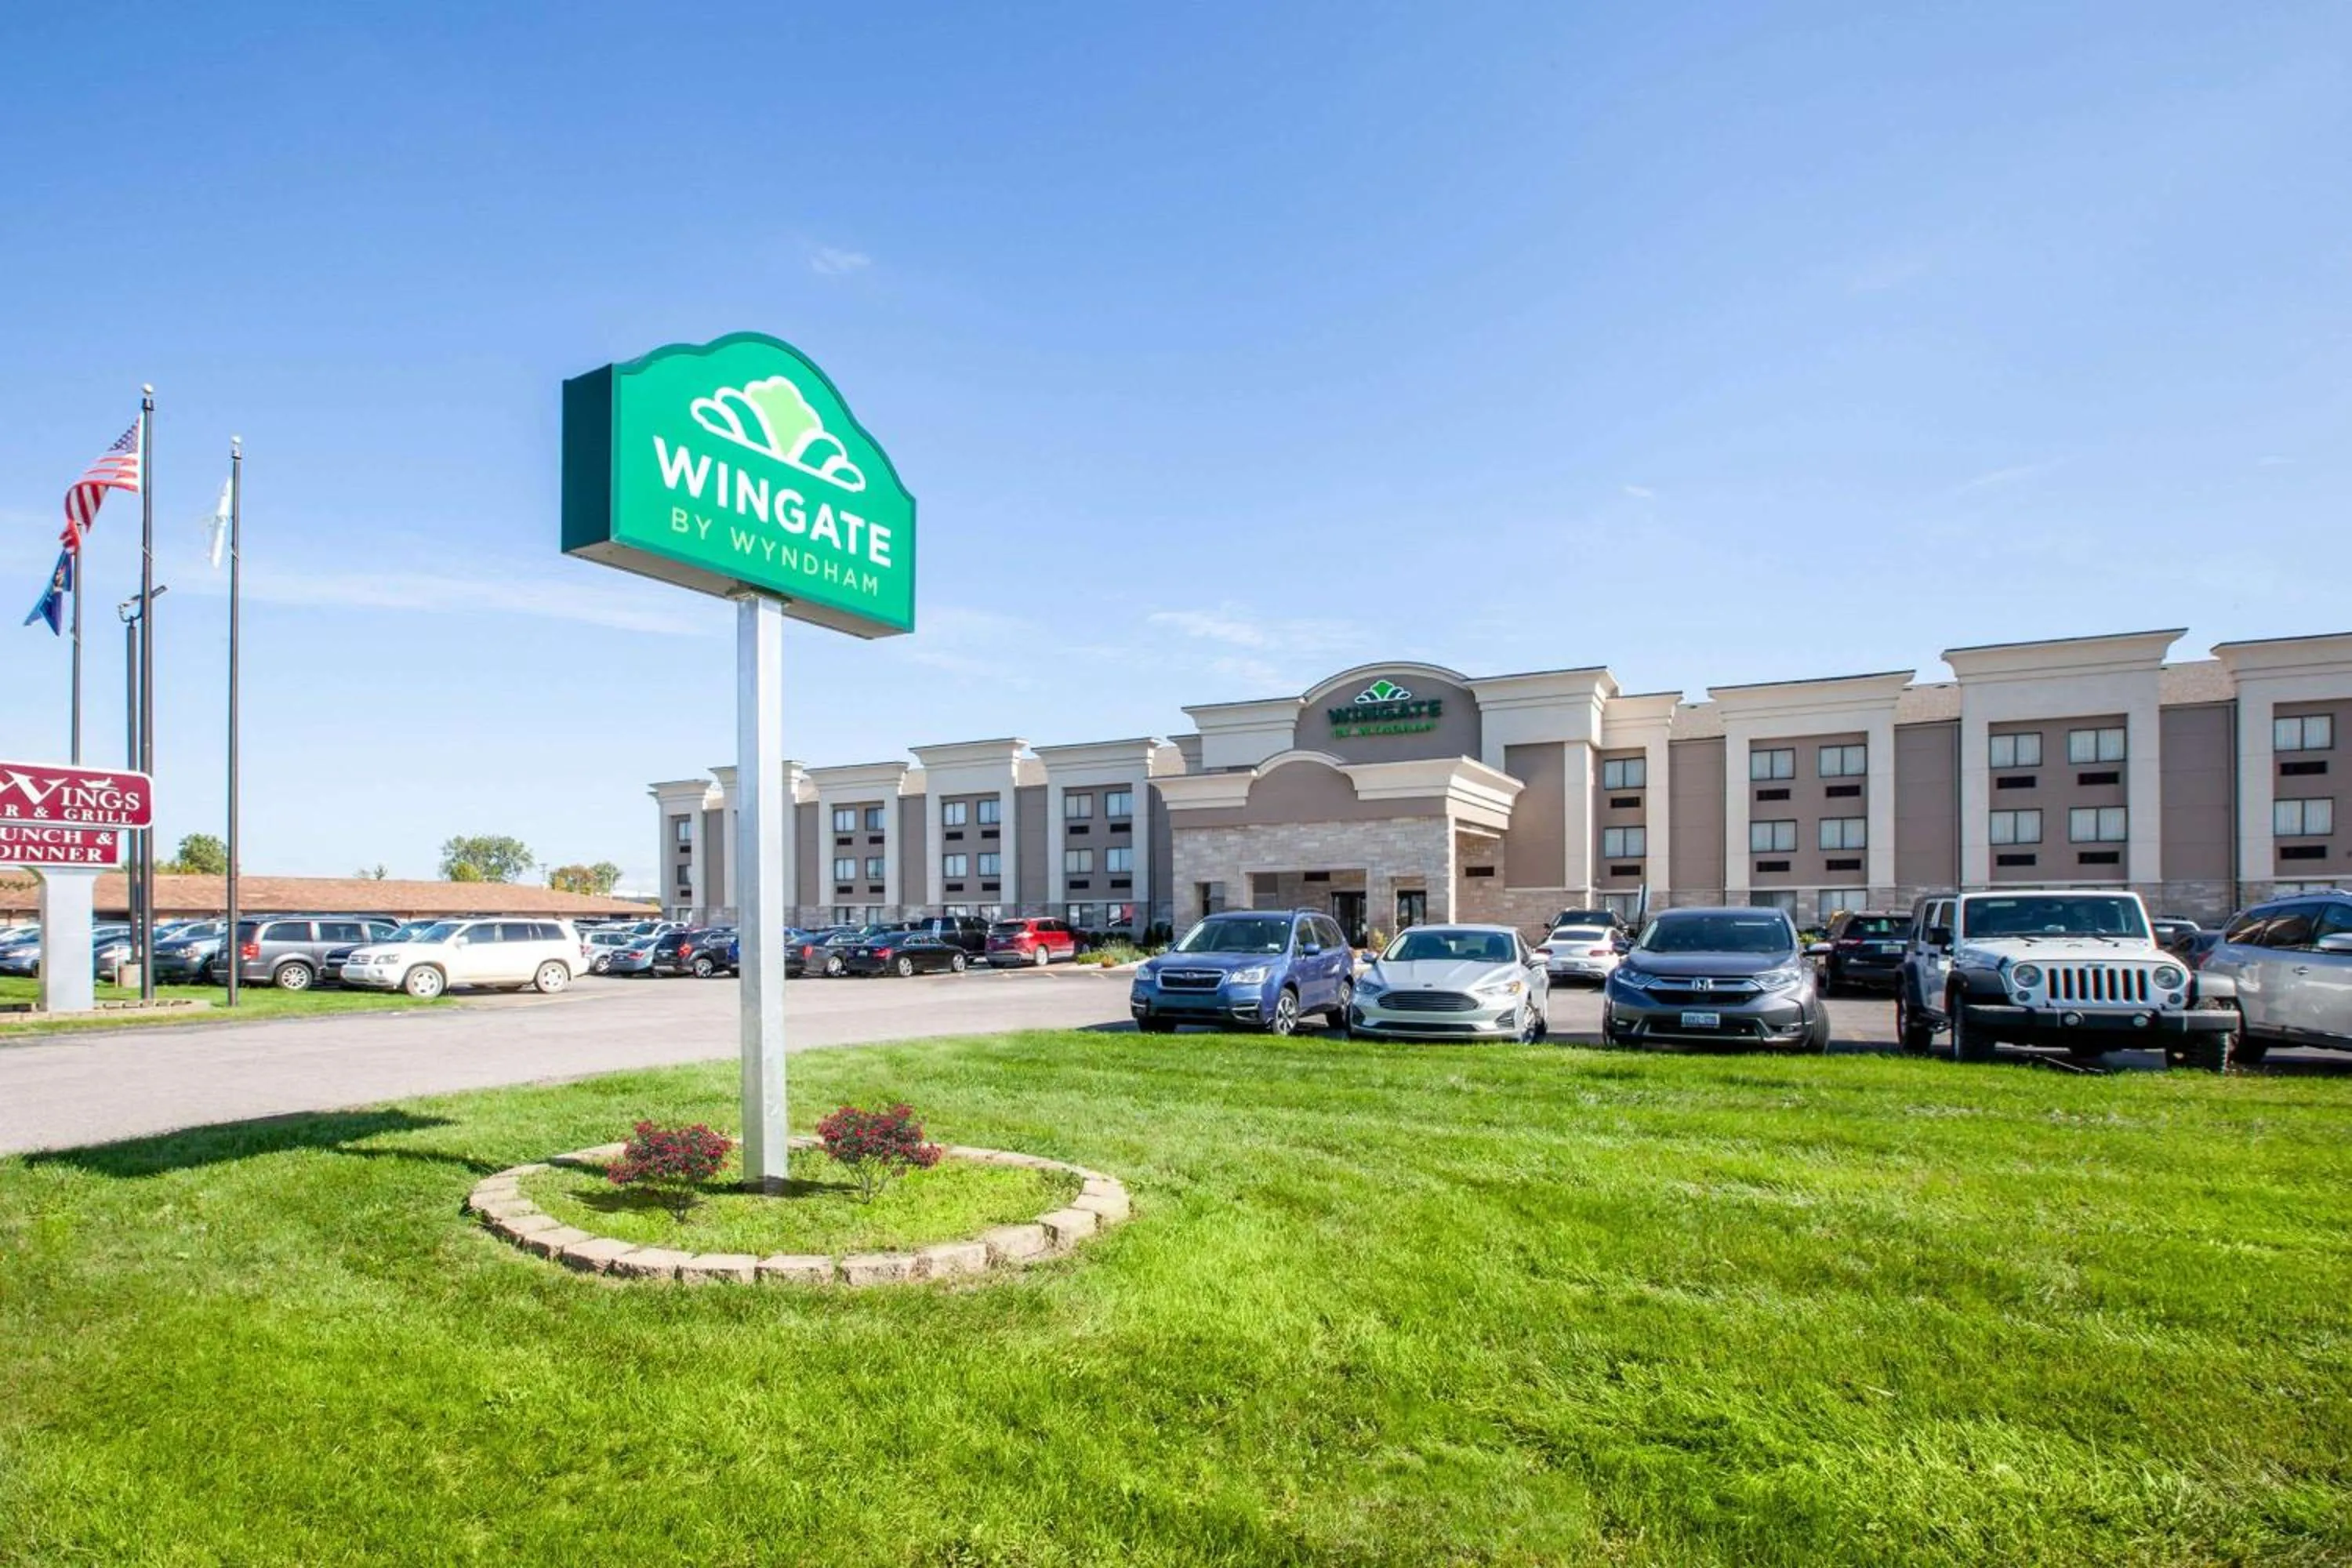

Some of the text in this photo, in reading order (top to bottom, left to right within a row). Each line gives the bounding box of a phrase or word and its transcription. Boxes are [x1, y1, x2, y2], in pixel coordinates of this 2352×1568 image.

[653, 435, 891, 568] WINGATE
[671, 506, 878, 596] BY WYNDHAM
[0, 804, 132, 823] R & GRILL
[0, 827, 113, 845] UNCH &
